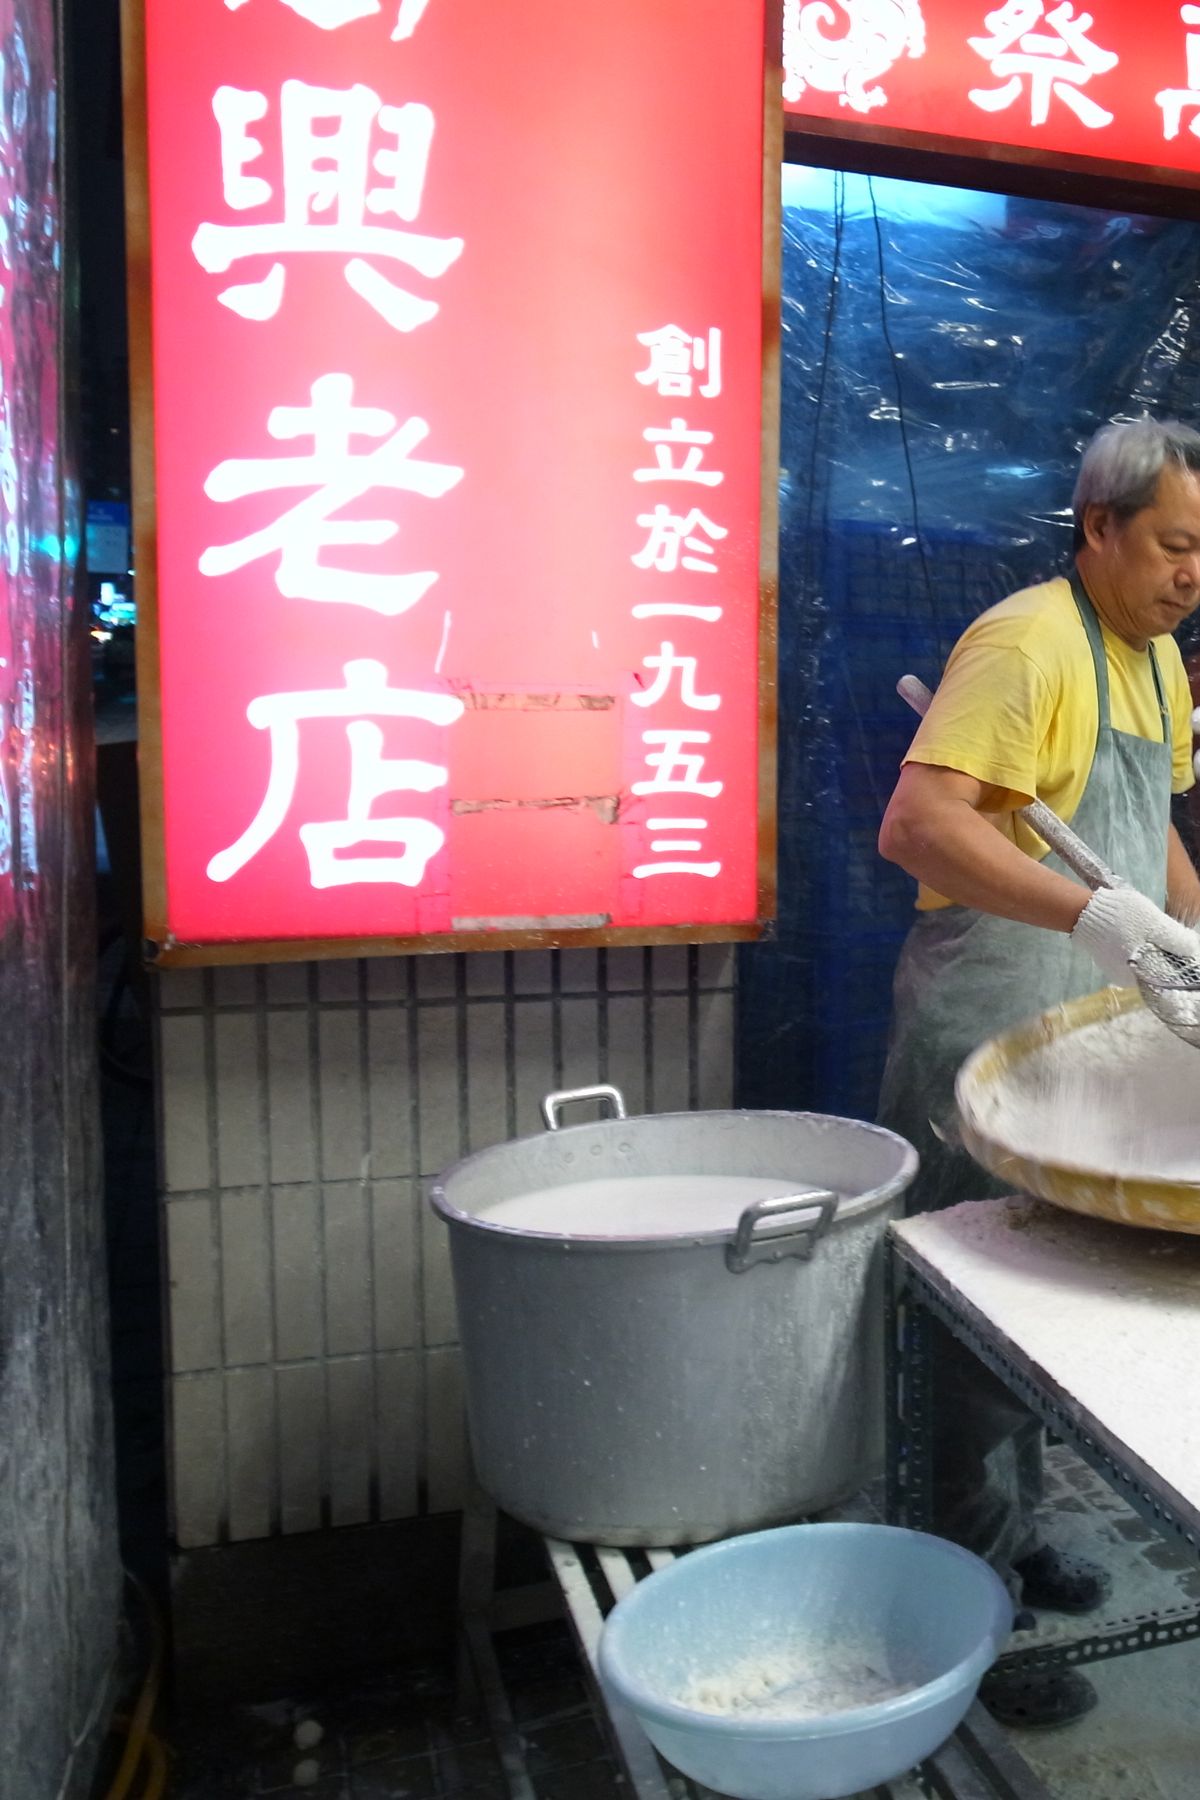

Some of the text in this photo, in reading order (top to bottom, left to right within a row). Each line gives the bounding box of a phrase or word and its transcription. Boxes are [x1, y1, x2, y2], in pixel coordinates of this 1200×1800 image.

[190, 0, 466, 889] 興老店
[630, 323, 728, 879] 創立於一九五三
